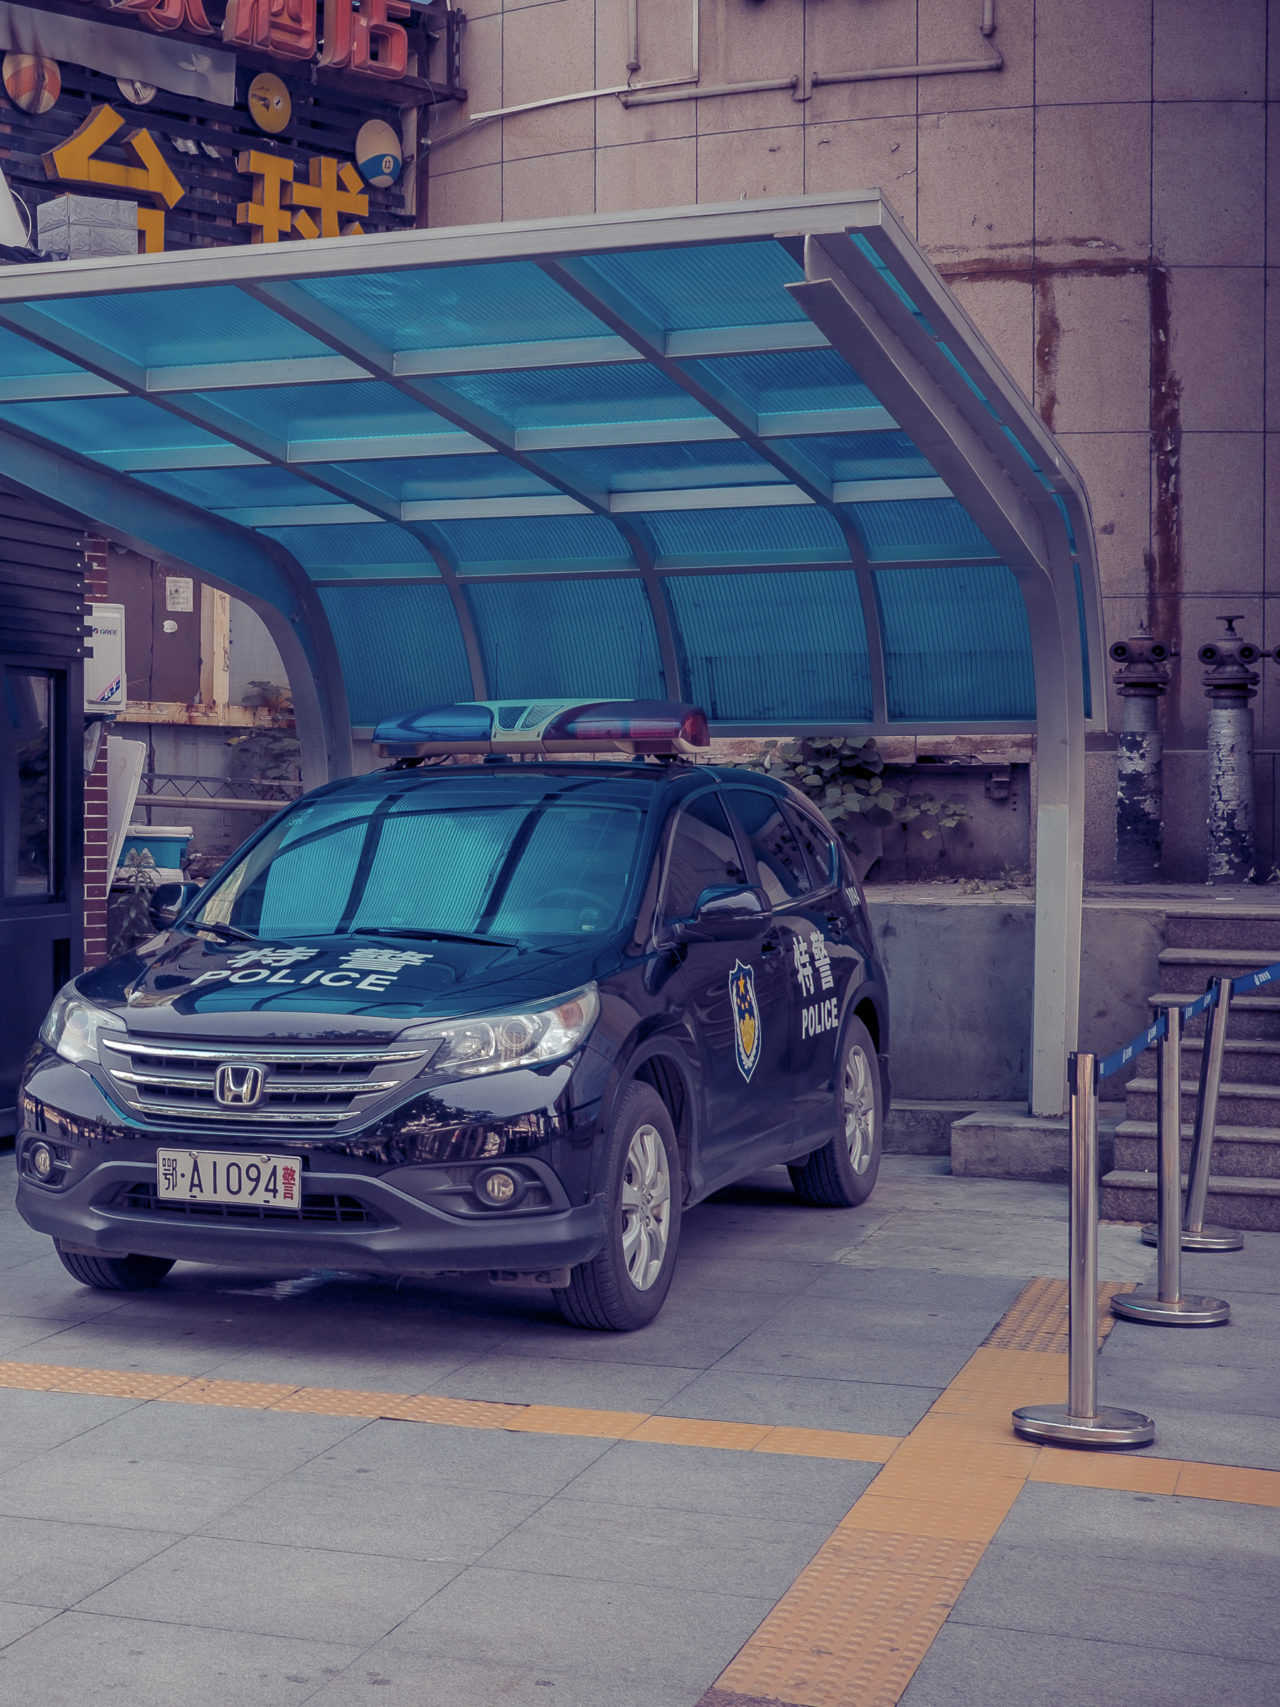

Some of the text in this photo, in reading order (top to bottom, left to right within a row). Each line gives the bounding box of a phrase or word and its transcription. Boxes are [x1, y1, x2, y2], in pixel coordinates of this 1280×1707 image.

[383, 160, 392, 170] 12
[42, 103, 369, 253] 台球
[99, 628, 118, 636] GREE
[227, 947, 434, 972] 特警
[793, 931, 834, 996] 特警
[190, 969, 398, 991] POLICE
[802, 997, 838, 1039] POLICE
